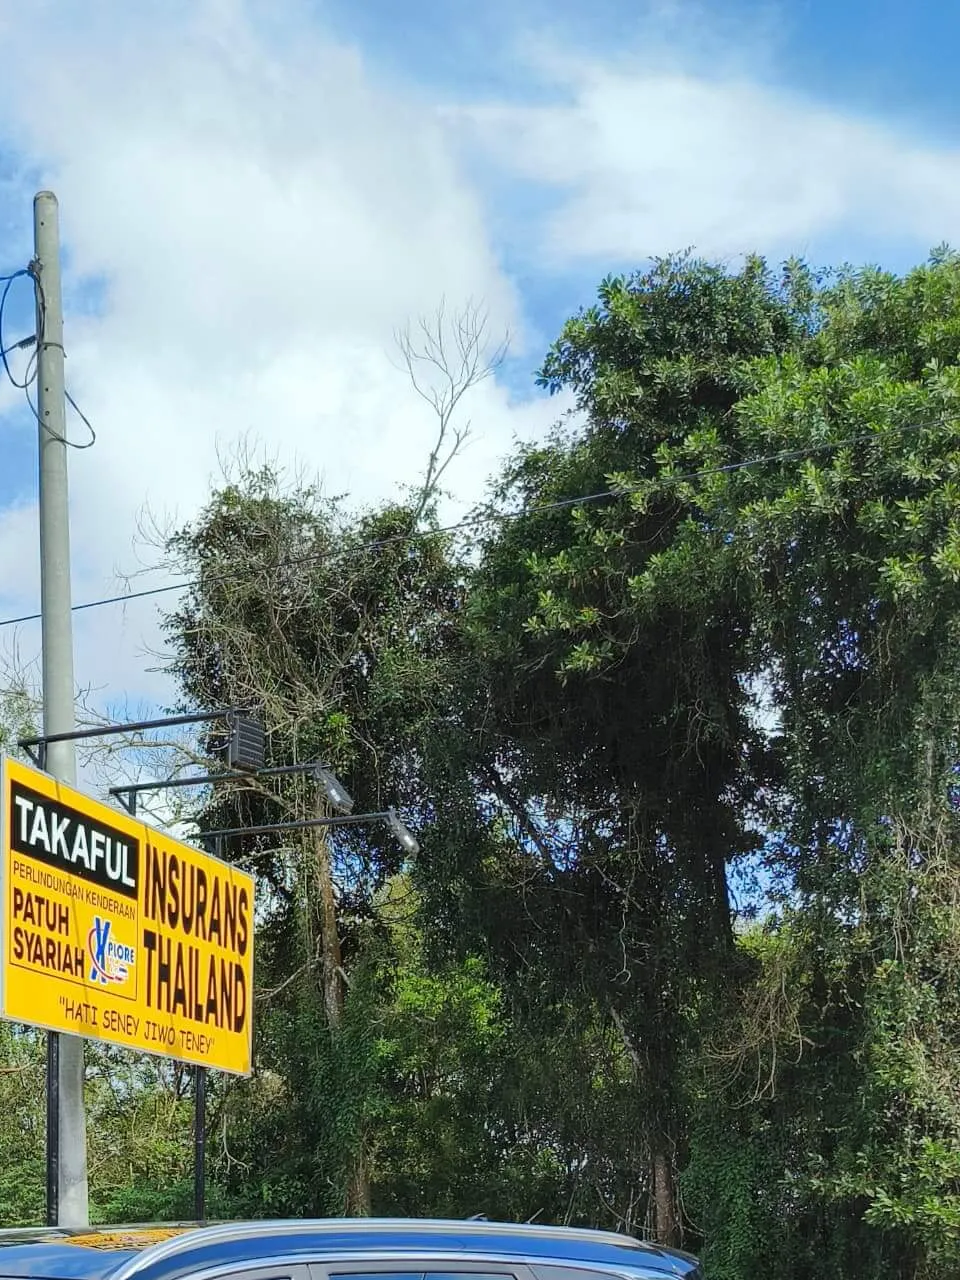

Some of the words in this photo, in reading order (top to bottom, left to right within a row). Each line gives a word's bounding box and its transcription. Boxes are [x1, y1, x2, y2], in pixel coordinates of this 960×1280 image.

[15, 796, 135, 887] TAKAFUL
[13, 861, 84, 900] PERLINDUNGAN
[85, 890, 135, 920] KENDERAAN
[13, 888, 69, 936] PATUH
[144, 843, 247, 956] INSURANS
[14, 928, 84, 978] SYARIAH
[144, 931, 246, 1033] THAILAND
[60, 996, 97, 1025] "HATI
[104, 1010, 140, 1039] SENEY
[144, 1021, 175, 1046] JIWO
[180, 1031, 215, 1054] TENEY"
